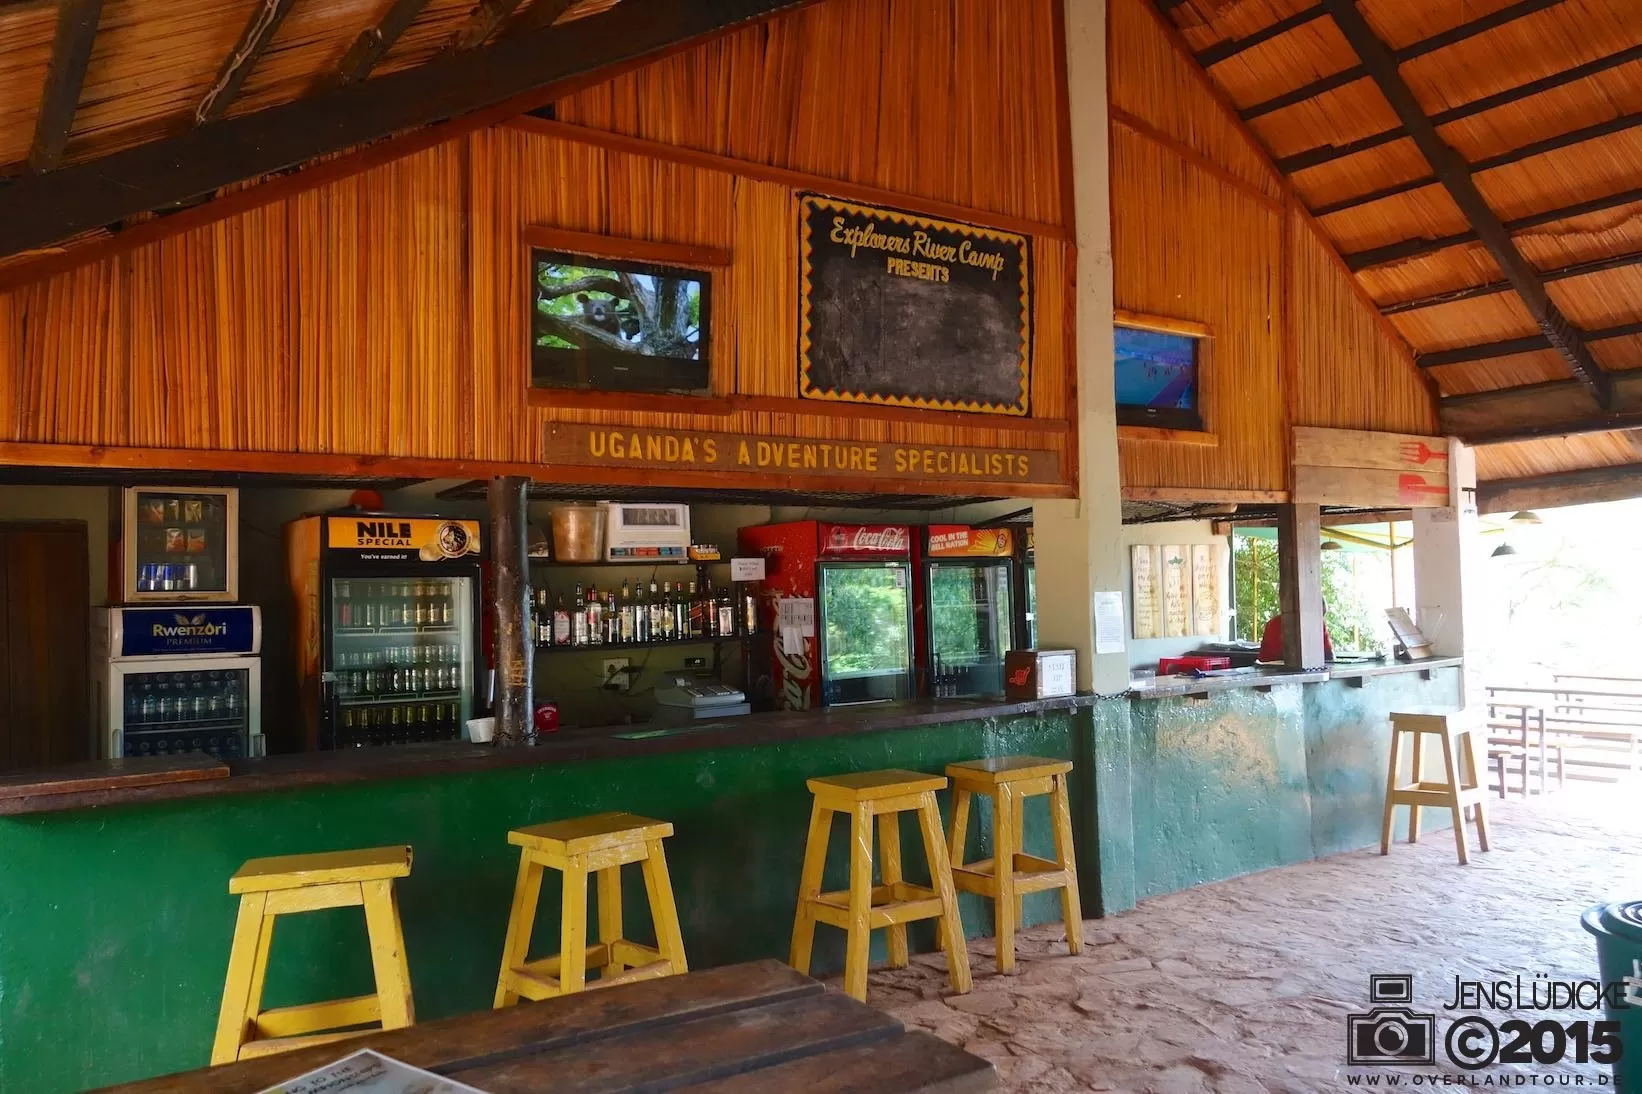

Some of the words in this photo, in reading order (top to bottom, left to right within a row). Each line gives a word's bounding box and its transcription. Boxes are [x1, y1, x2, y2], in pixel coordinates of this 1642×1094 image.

[830, 216, 910, 259] Explorers
[912, 230, 957, 264] River
[959, 240, 1005, 281] Camp
[887, 256, 950, 283] PRESENTS
[589, 431, 717, 464] UGANDA'S
[737, 439, 878, 472] ADVENTURE
[894, 448, 1029, 477] SPECIALISTS
[356, 521, 412, 538] NILE
[930, 534, 947, 544] COOL
[948, 533, 956, 541] IN
[957, 531, 969, 540] THE
[357, 538, 412, 546] SPECIAL
[152, 622, 227, 637] Rwenzori
[166, 638, 212, 646] PREMIUM
